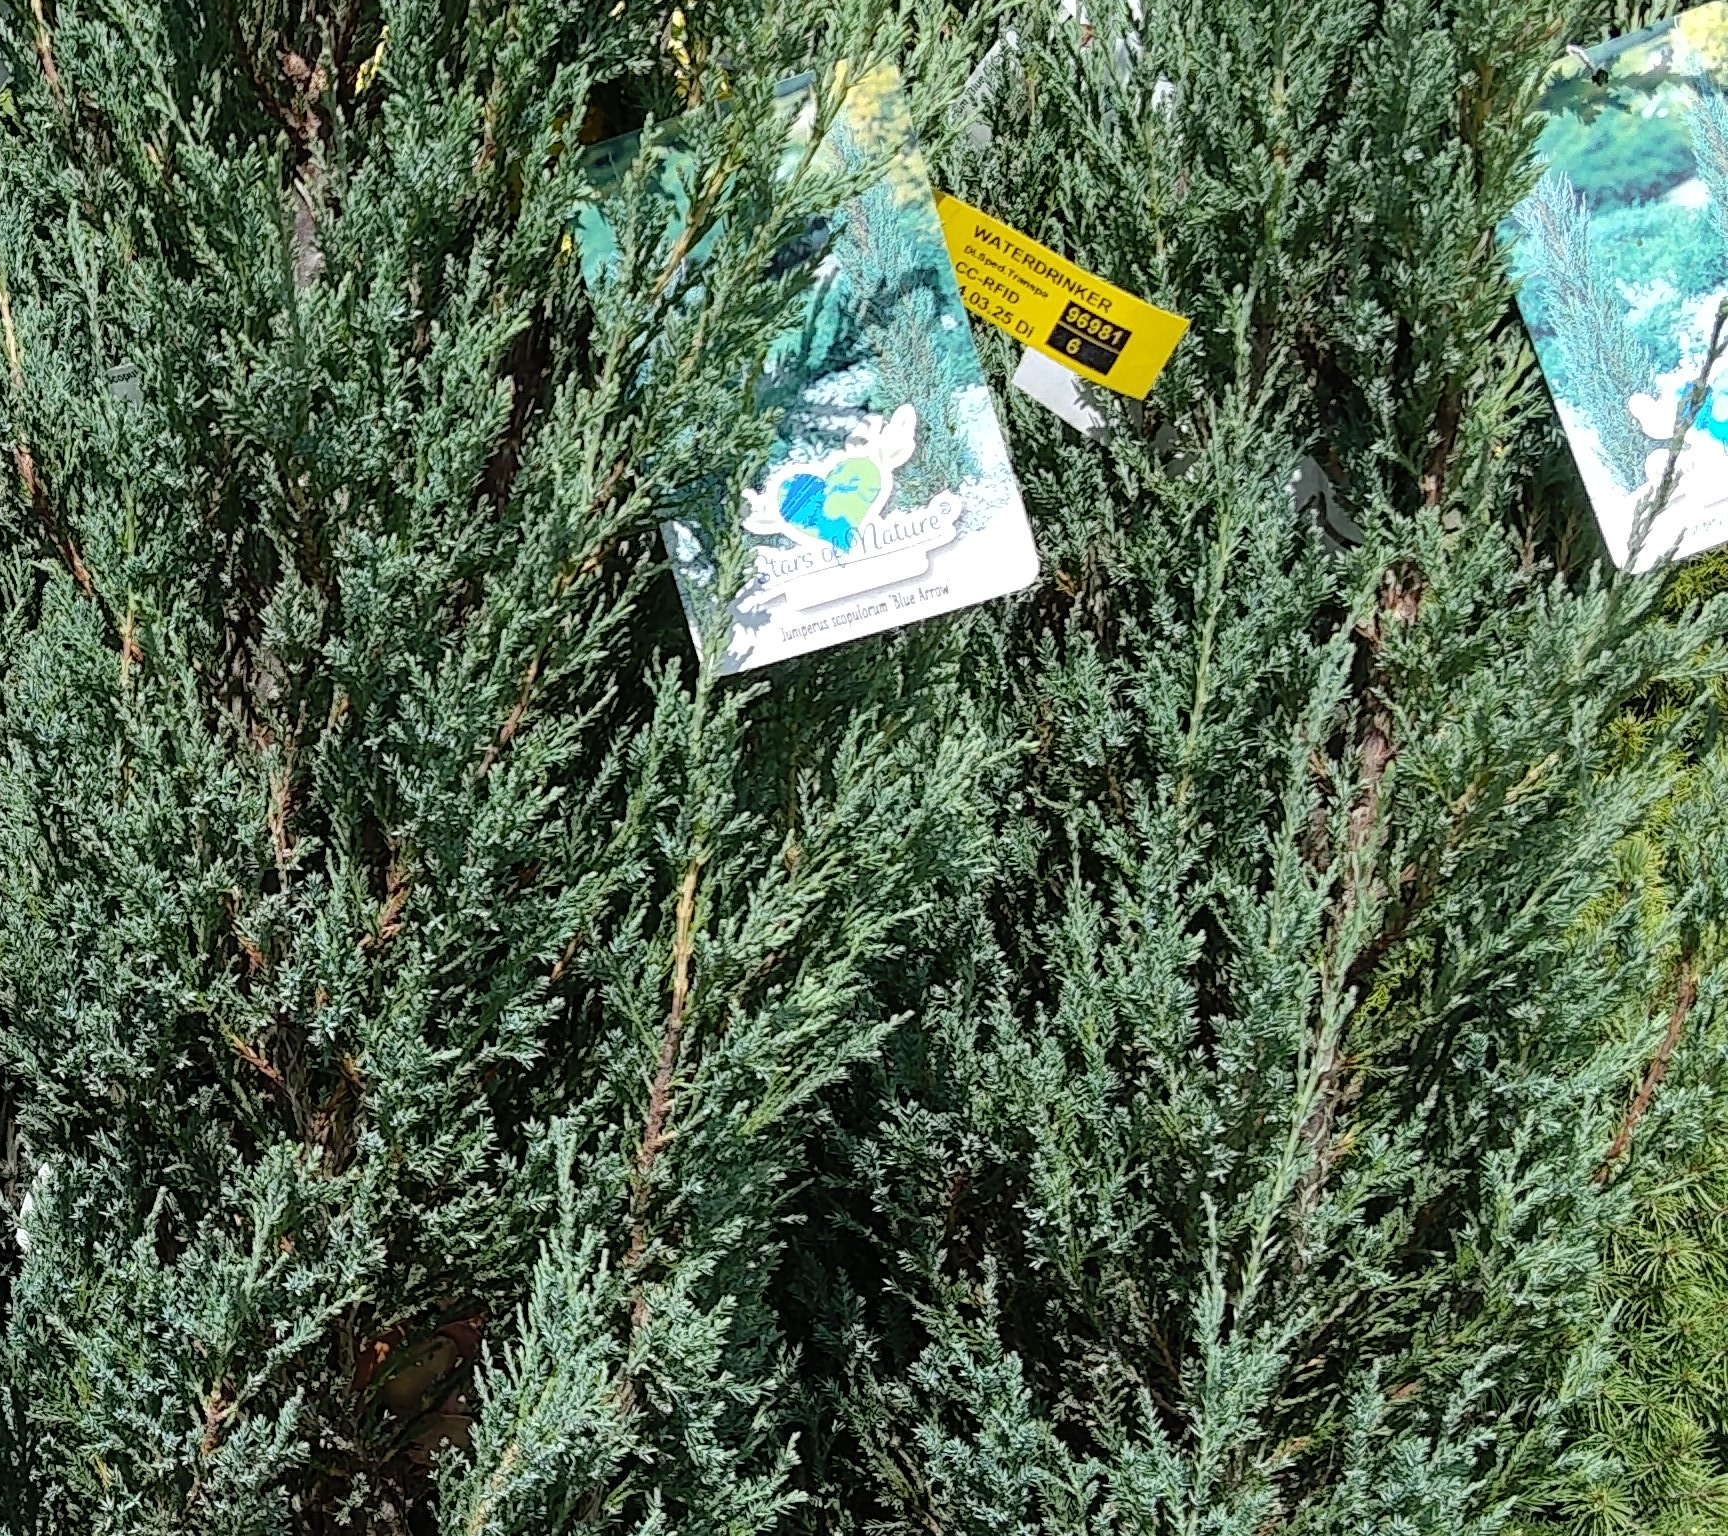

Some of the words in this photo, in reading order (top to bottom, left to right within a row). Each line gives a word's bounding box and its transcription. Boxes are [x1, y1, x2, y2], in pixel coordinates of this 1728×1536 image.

[955, 261, 1020, 305] CC-RFID
[973, 224, 1114, 314] WATERDRINKER
[1015, 319, 1036, 340] Di
[1065, 306, 1124, 346] 96981
[1065, 337, 1081, 355] 6
[779, 620, 830, 643] Juniperus
[831, 601, 889, 628] scopulorum
